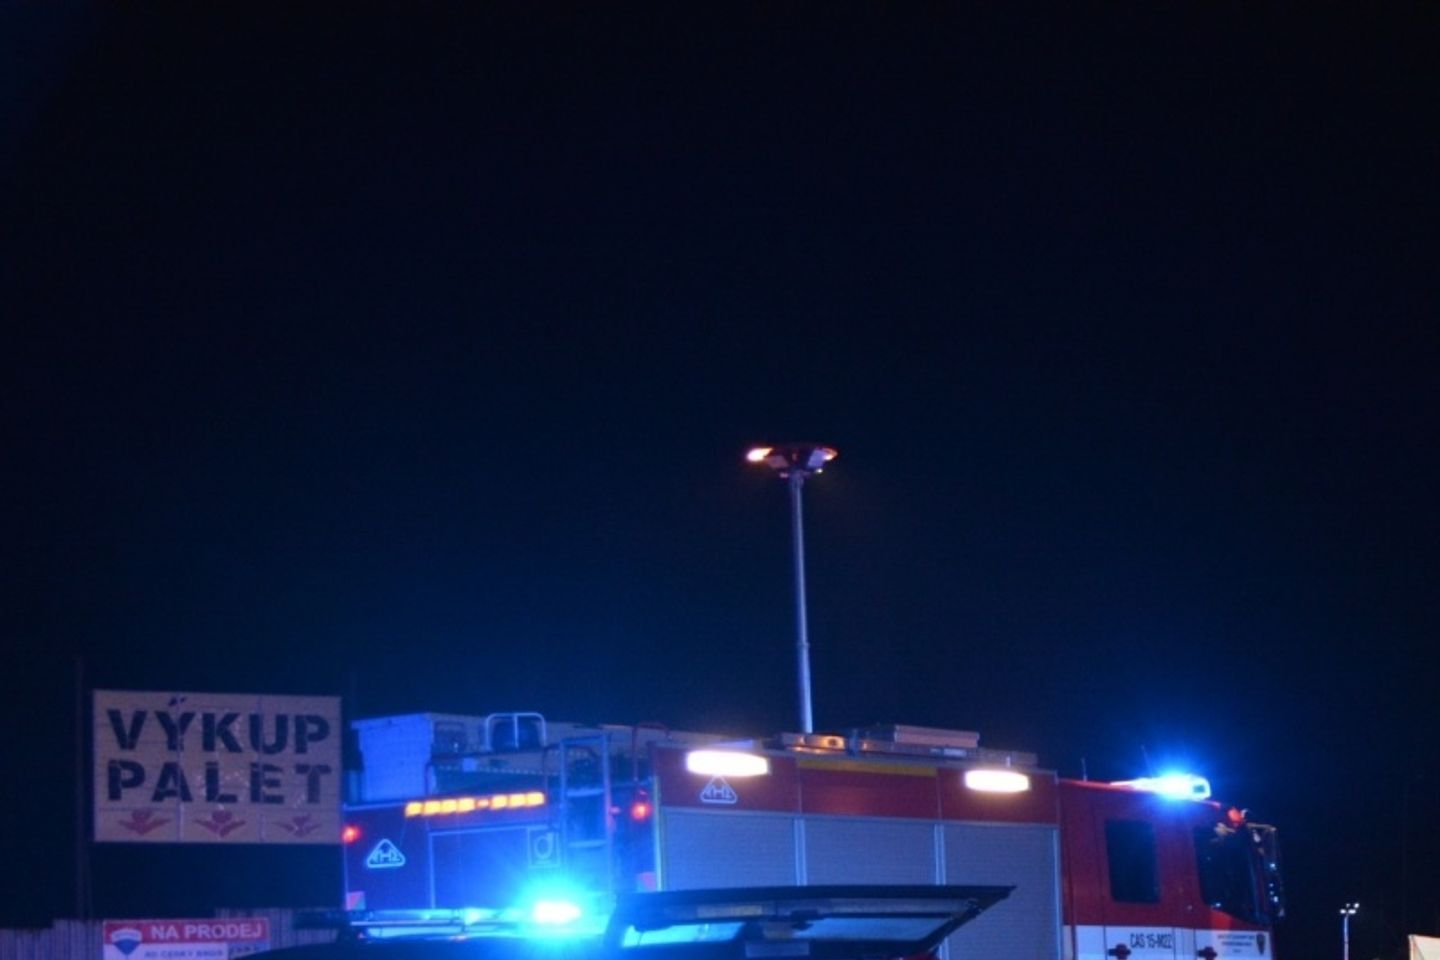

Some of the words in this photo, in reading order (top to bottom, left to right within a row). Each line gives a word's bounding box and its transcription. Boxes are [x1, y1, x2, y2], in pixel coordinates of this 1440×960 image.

[106, 698, 331, 755] VÝKUP
[106, 760, 333, 804] PALET
[151, 924, 180, 940] NA
[184, 922, 263, 940] PRODEJ
[1130, 932, 1145, 949] CAS
